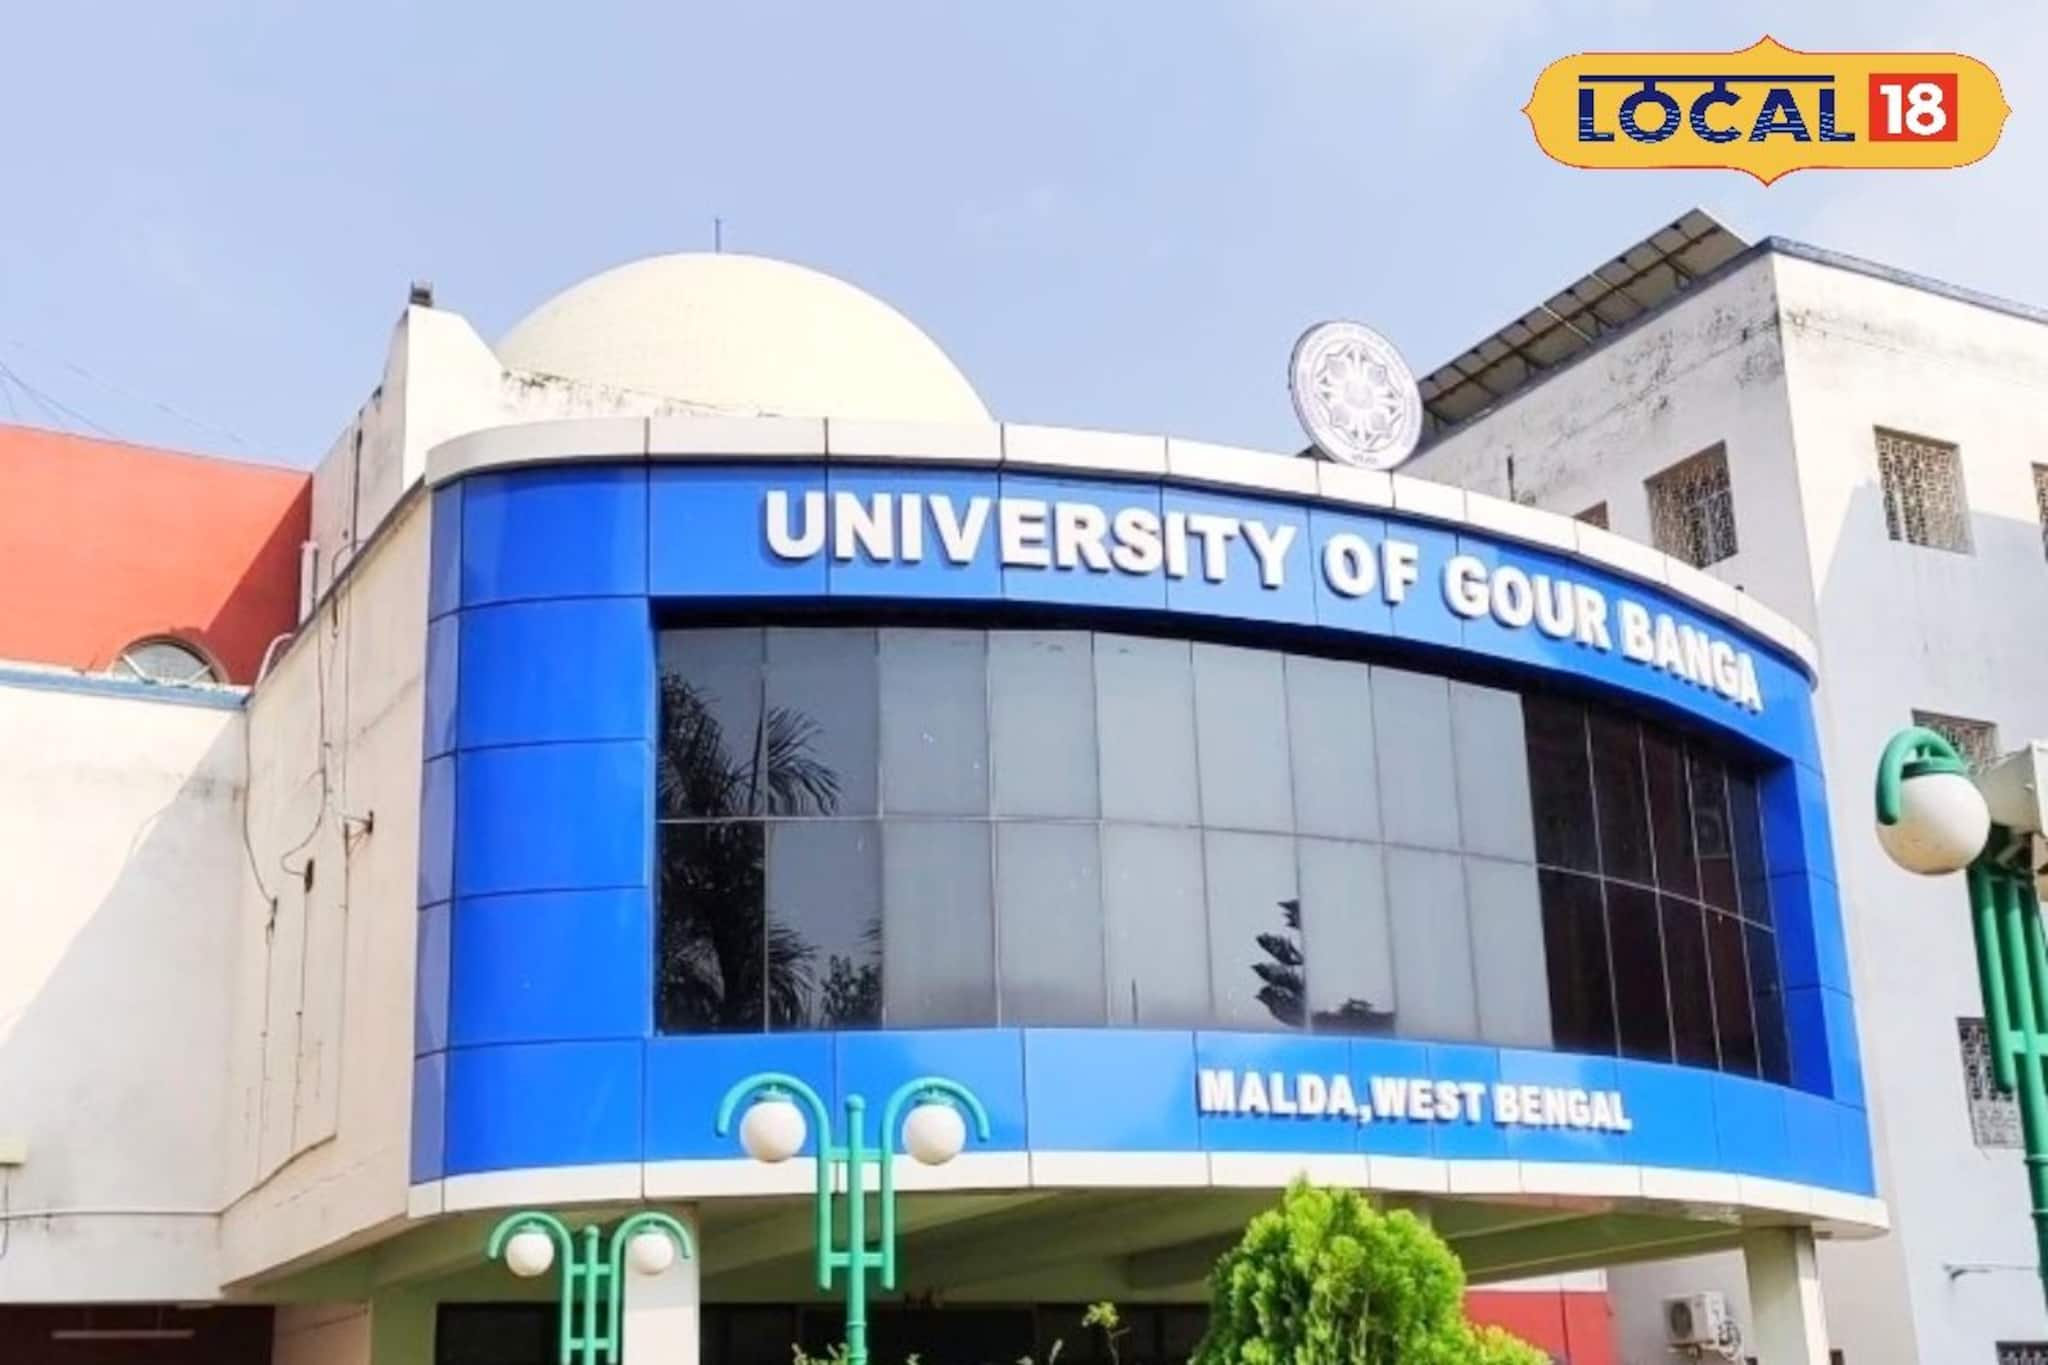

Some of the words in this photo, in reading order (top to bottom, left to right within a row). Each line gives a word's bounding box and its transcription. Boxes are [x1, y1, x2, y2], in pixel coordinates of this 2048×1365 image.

[765, 489, 1296, 588] UNIVERSITY
[1323, 533, 1419, 605] OF
[1443, 554, 1612, 652] GOUR
[1618, 600, 1763, 712] BANGA
[1492, 1083, 1633, 1132] BENGAL
